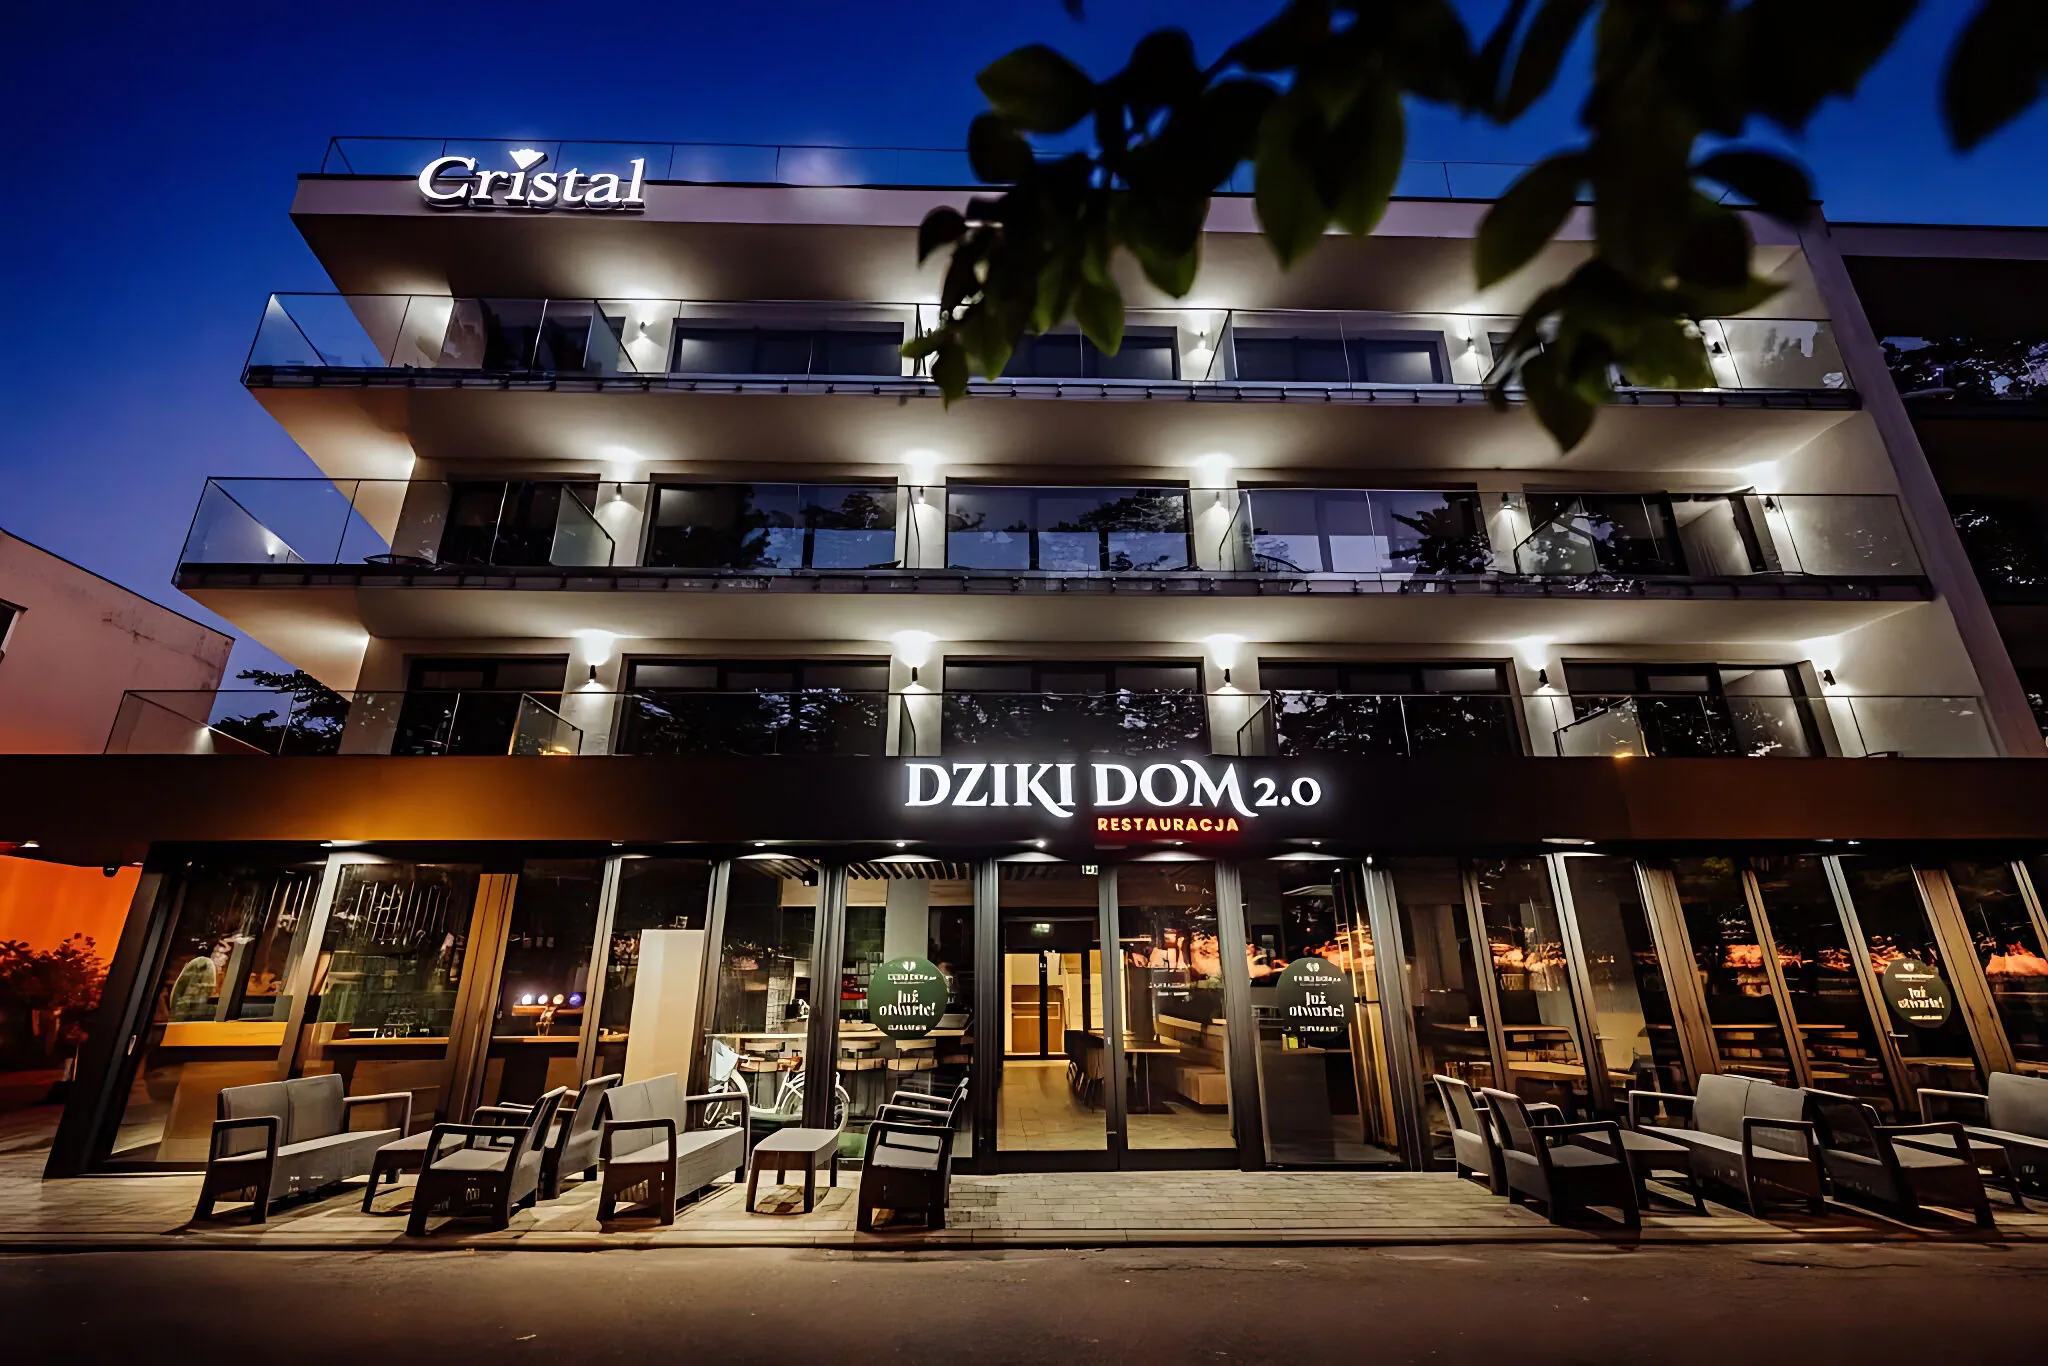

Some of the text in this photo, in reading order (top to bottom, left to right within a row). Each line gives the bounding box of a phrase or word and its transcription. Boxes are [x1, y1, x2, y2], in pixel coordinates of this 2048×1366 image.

[418, 149, 646, 206] Cristal
[904, 759, 1322, 818] DZIKI DOM 2.0
[1097, 817, 1240, 832] RESTAURACJA
